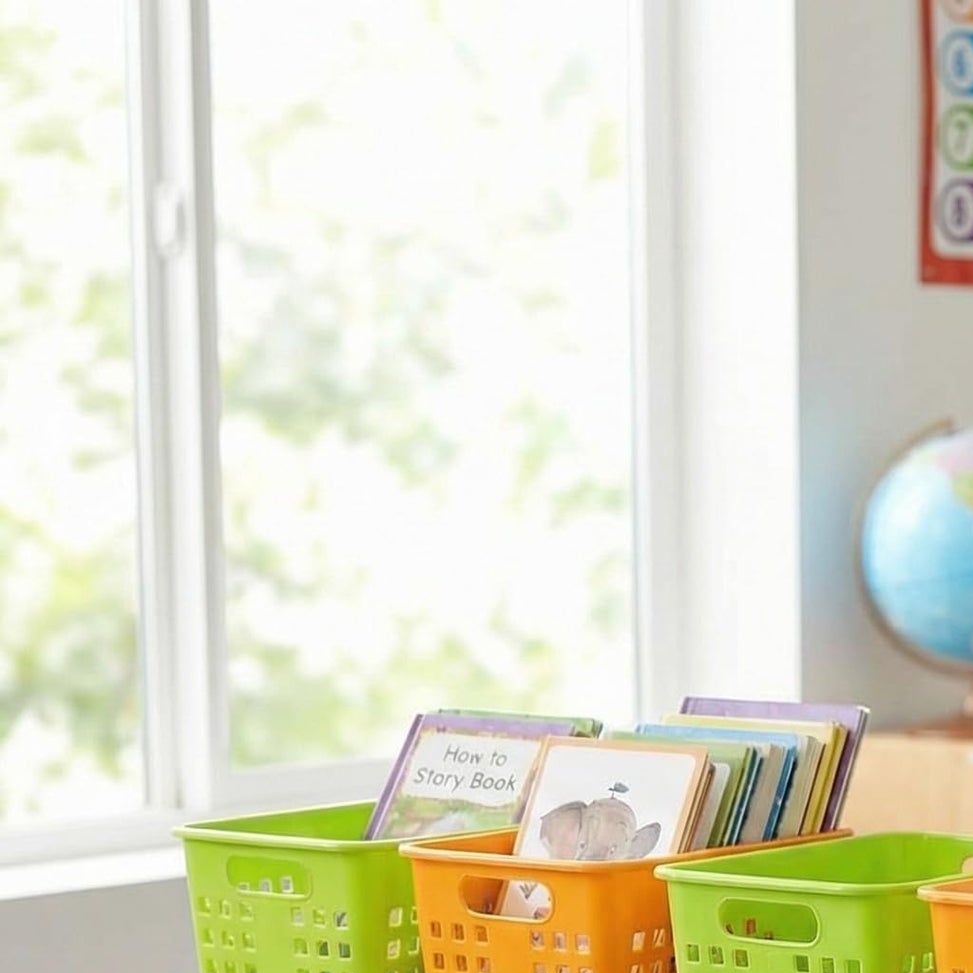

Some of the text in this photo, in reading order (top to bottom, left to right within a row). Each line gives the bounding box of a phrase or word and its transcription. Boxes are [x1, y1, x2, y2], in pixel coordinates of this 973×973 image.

[443, 744, 508, 767] How to
[413, 767, 516, 793] Story Book
